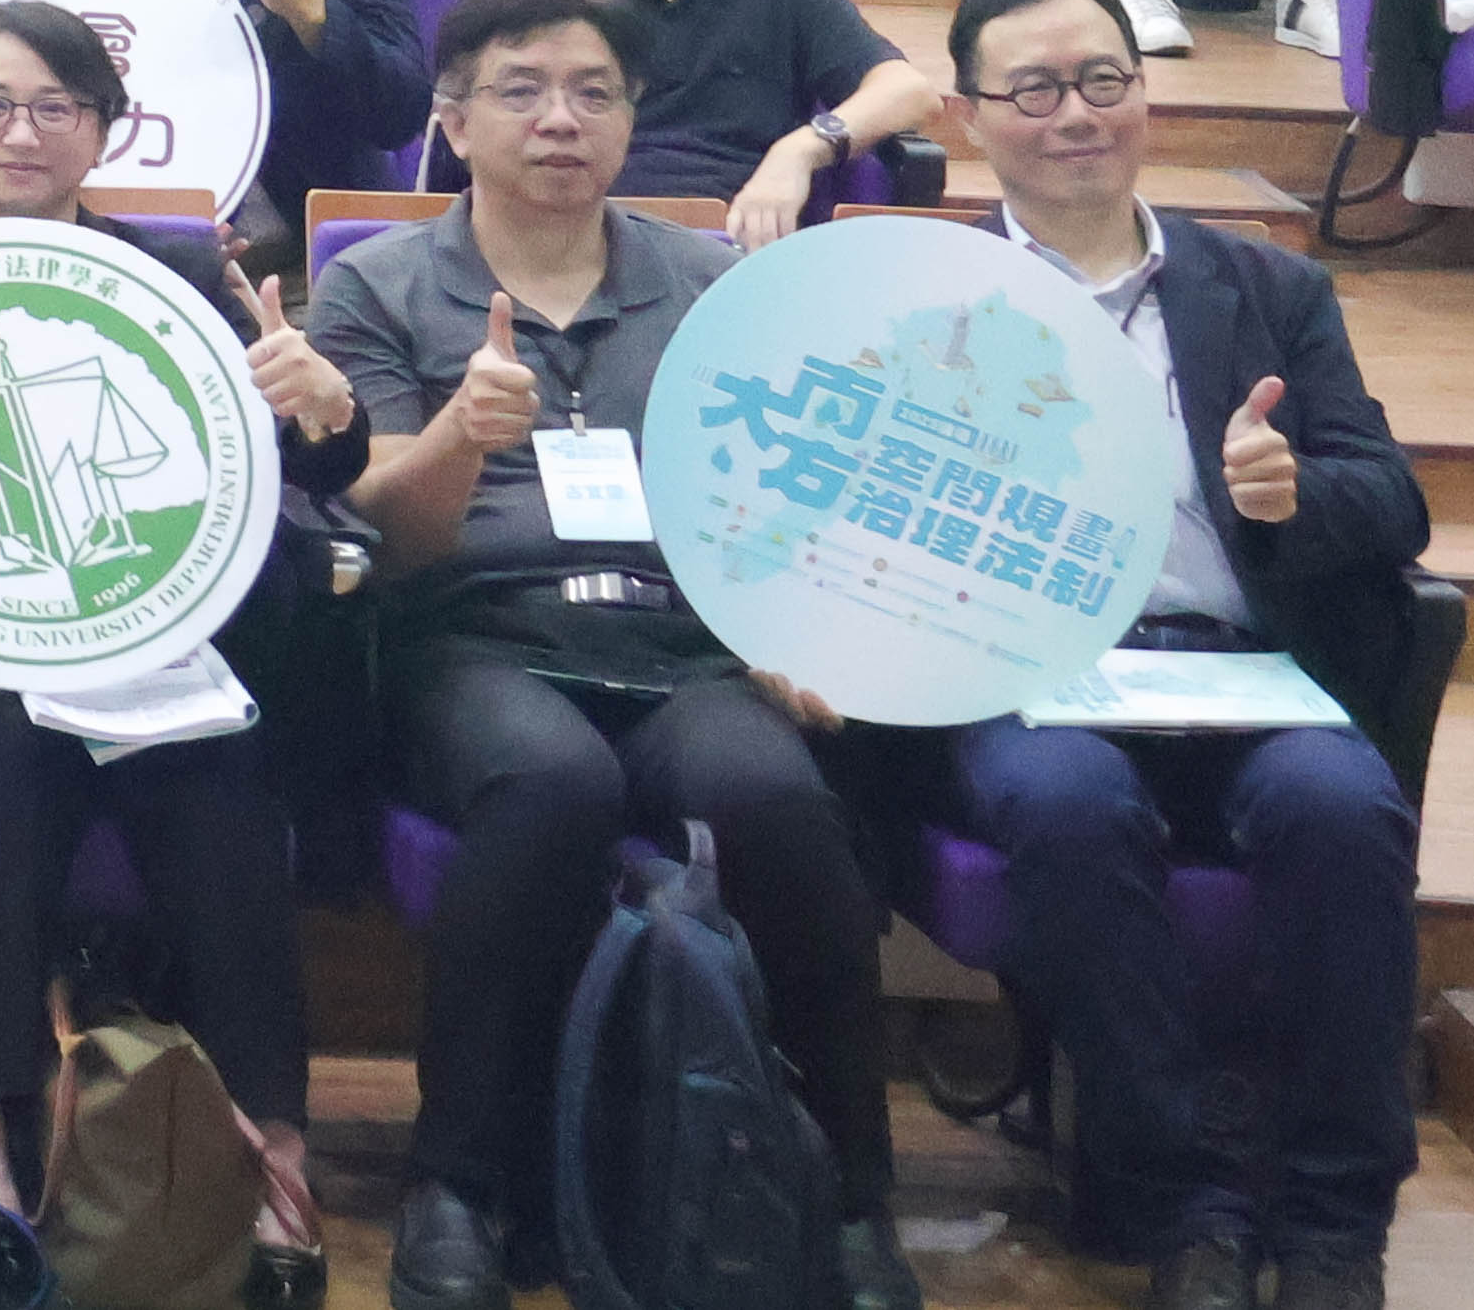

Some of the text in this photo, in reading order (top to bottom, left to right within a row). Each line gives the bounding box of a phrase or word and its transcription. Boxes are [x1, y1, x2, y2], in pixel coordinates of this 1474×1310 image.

[201, 369, 237, 432] LAW
[222, 434, 238, 465] OF
[158, 471, 238, 609] DEPARTMENT
[843, 481, 1116, 617] 治理法制
[0, 570, 143, 617] SINCE 1996
[13, 601, 158, 649] UNIVERSITY
